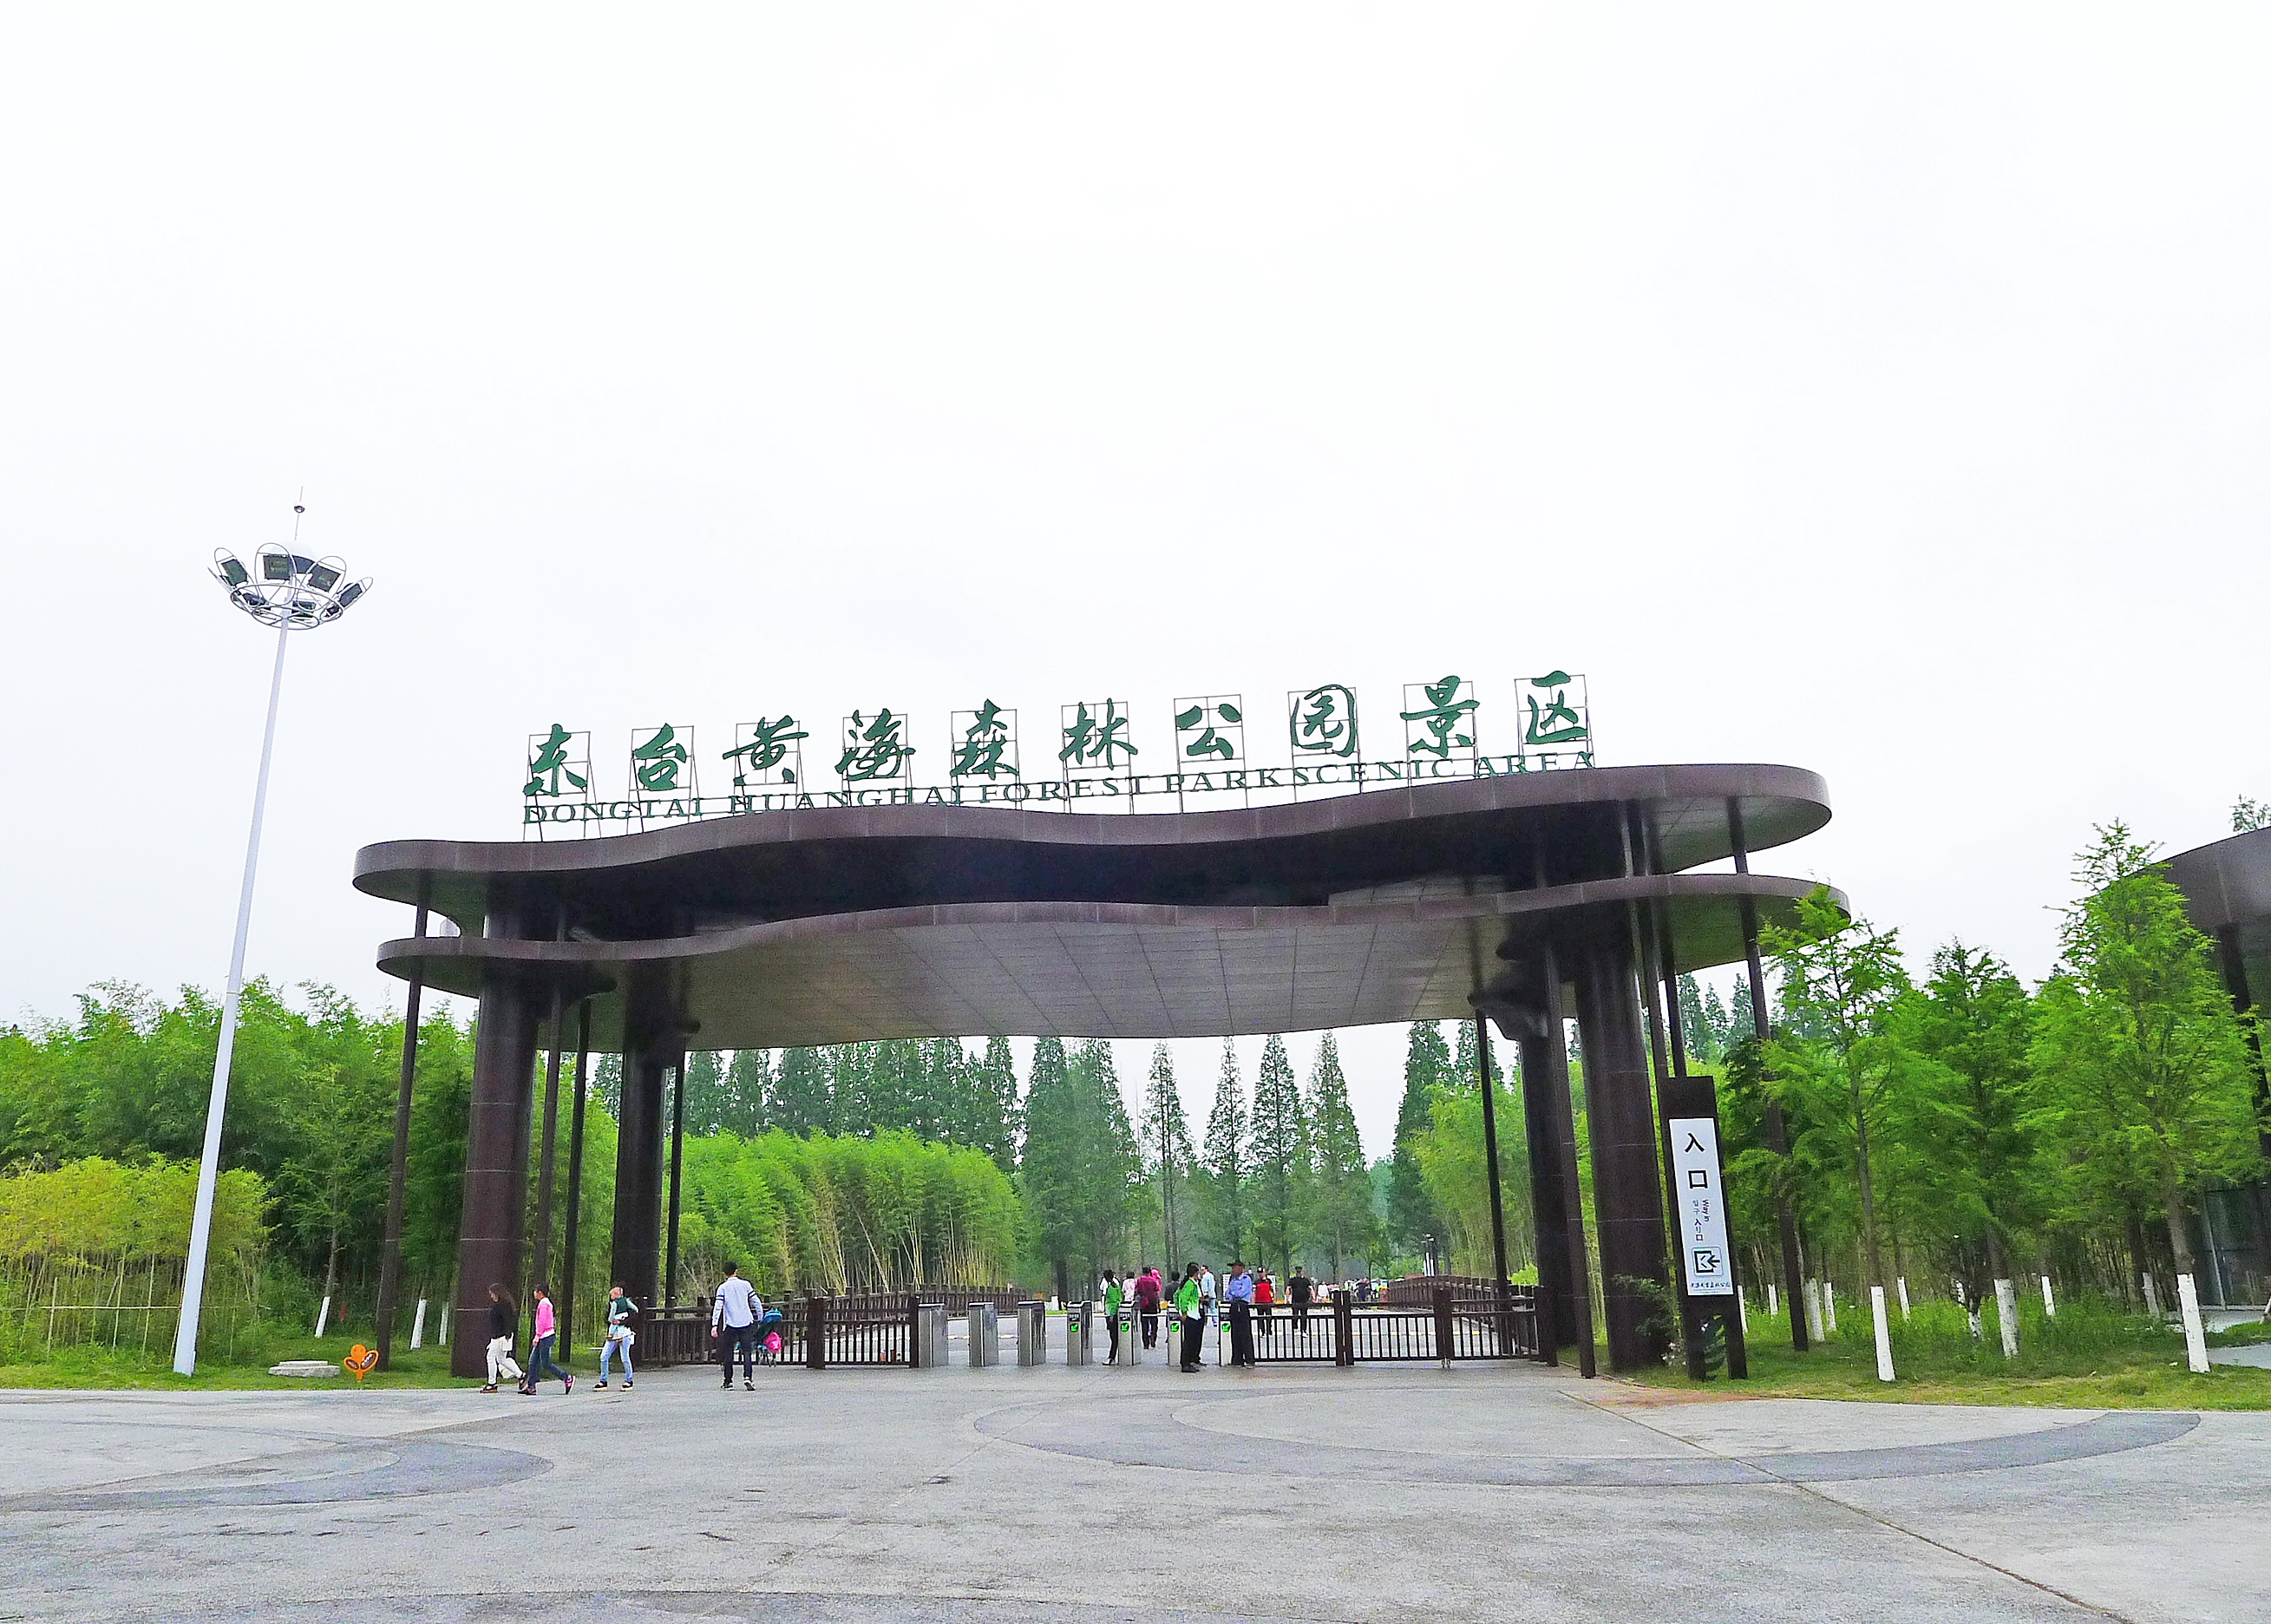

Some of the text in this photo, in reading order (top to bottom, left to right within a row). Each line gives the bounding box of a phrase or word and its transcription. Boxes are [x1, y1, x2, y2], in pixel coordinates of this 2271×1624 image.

[523, 751, 1595, 824] DONGTAI HUANGHAI FOREST PARK SCENIC AREA
[1685, 1132, 1708, 1189] 入口
